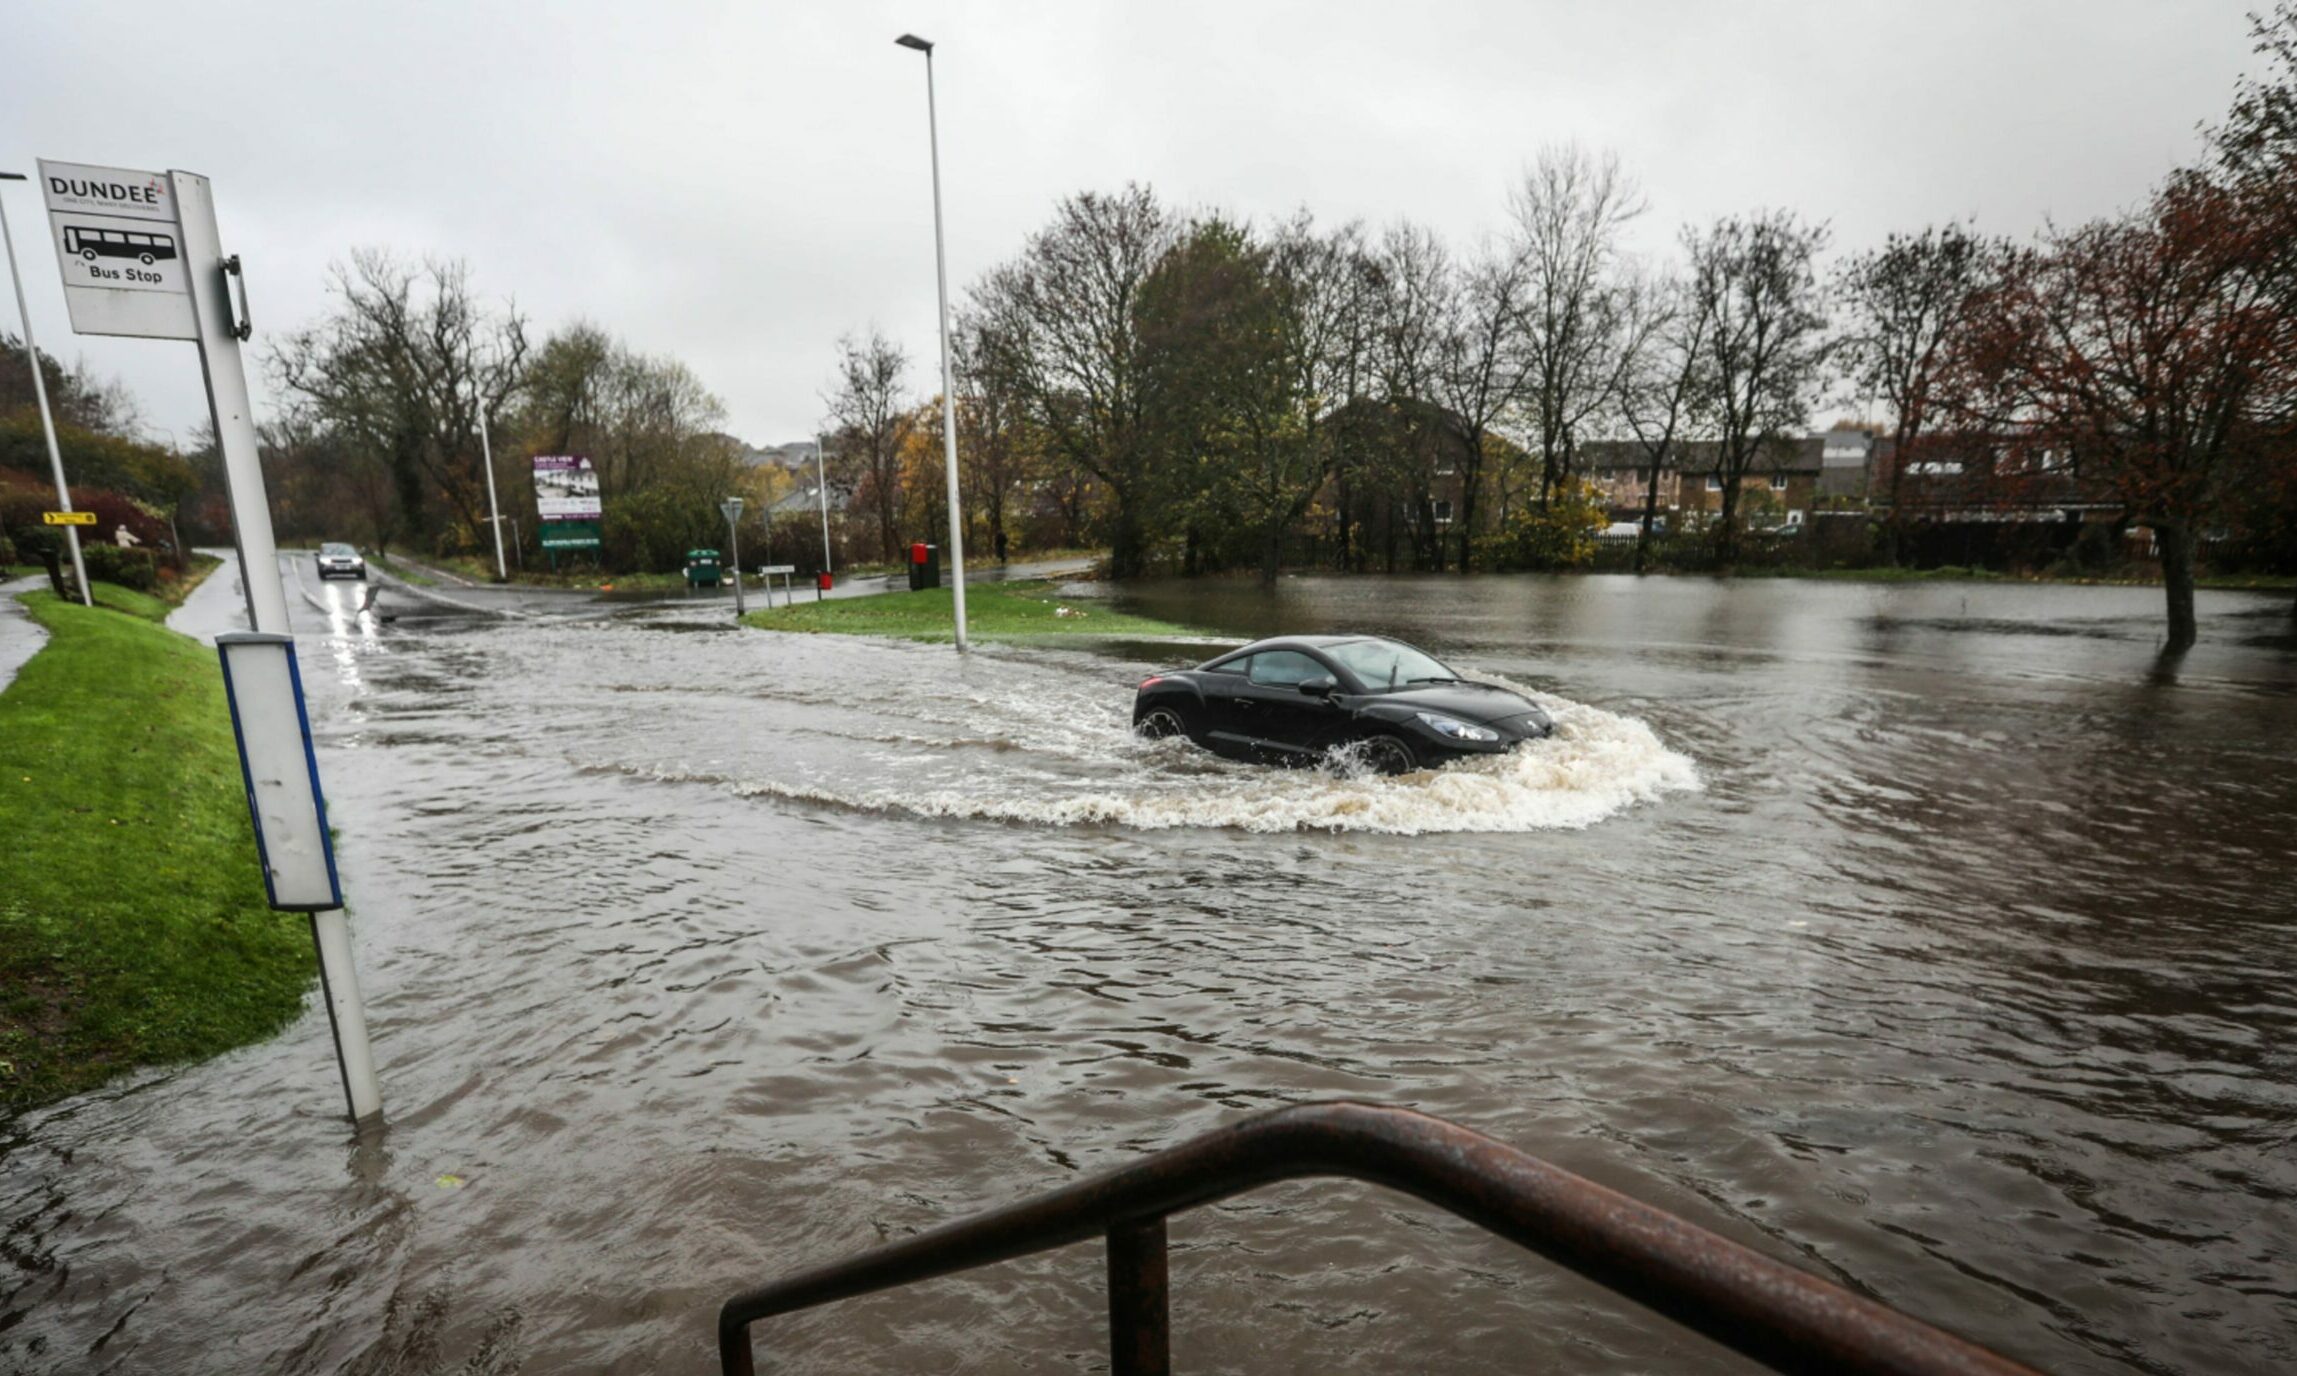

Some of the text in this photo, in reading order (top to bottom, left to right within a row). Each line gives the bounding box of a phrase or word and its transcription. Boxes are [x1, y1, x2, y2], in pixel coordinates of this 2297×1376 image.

[49, 176, 158, 204] DUNDEE
[90, 265, 162, 285] Bus Stop
